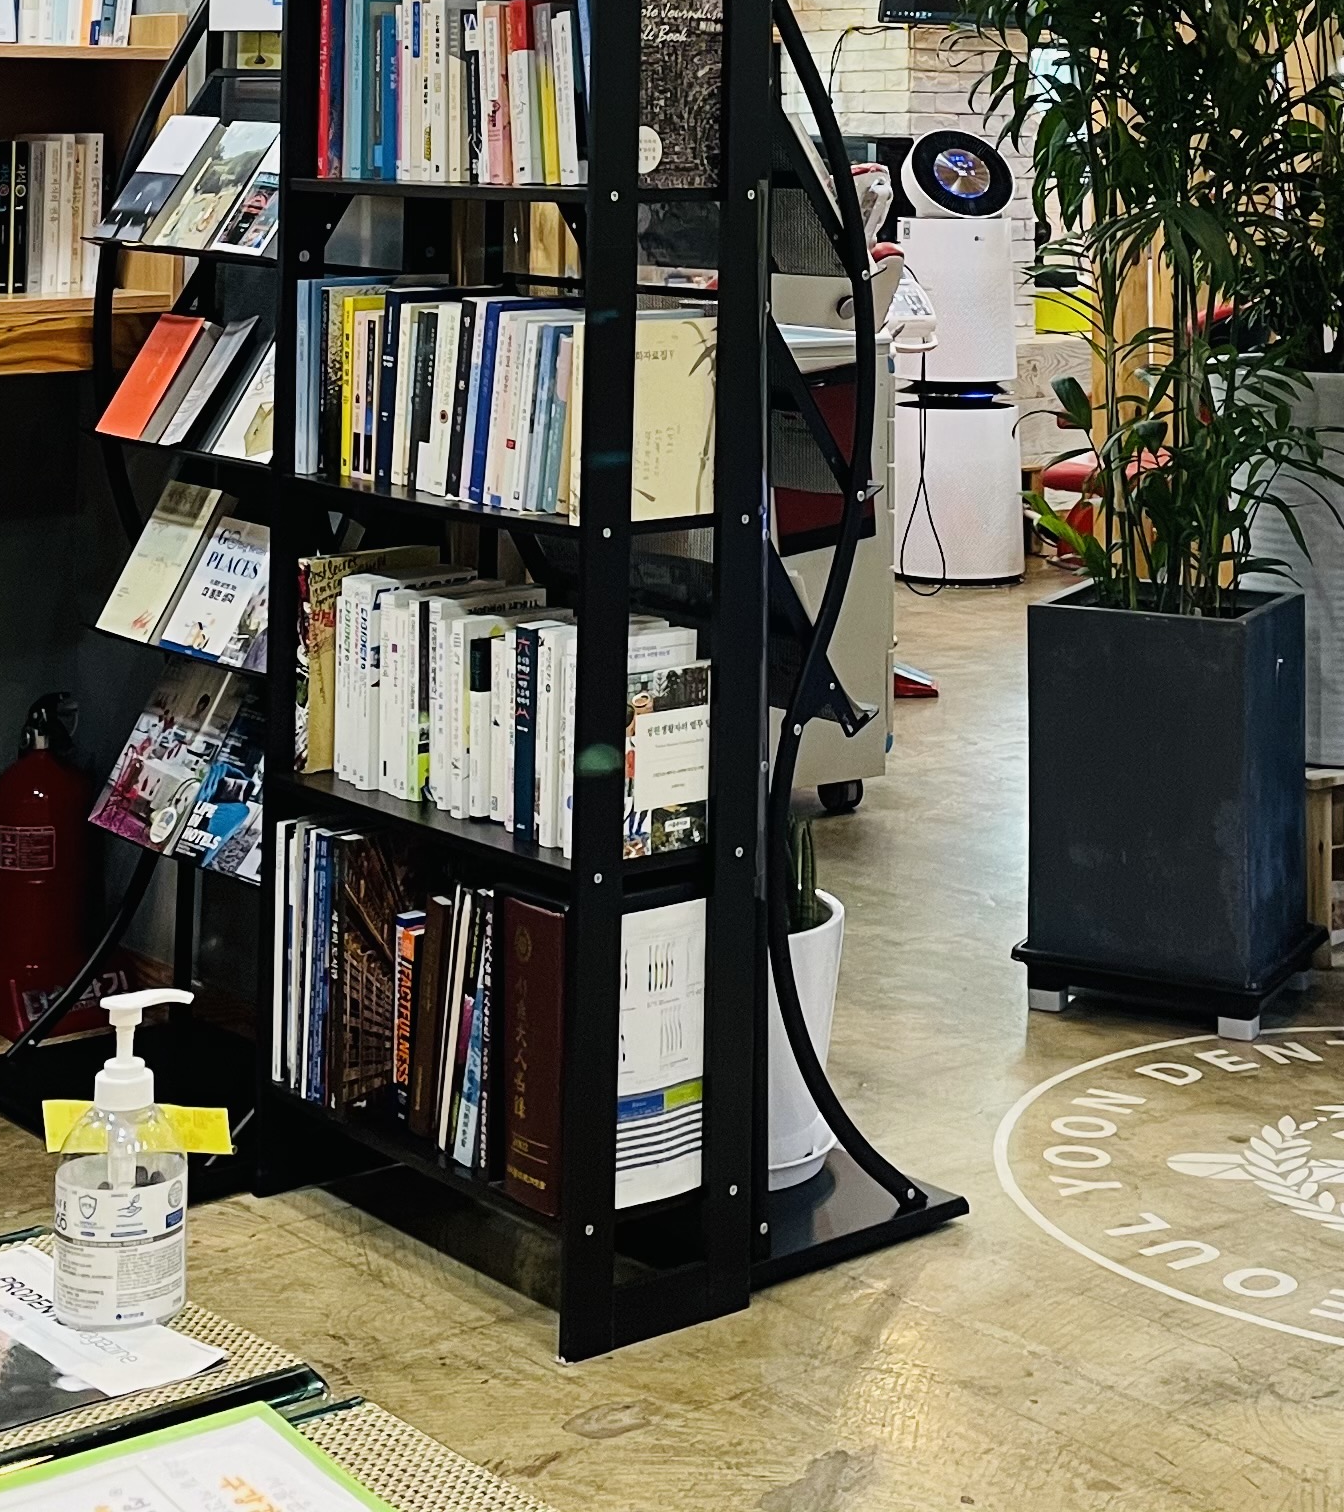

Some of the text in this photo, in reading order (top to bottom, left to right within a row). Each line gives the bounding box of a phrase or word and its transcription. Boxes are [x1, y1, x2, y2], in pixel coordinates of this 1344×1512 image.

[658, 24, 689, 43] Book
[206, 551, 262, 580] PLACES
[181, 827, 222, 850] HOTELS
[397, 965, 413, 1087] FACTFULNESS
[1042, 1087, 1149, 1199] YOON
